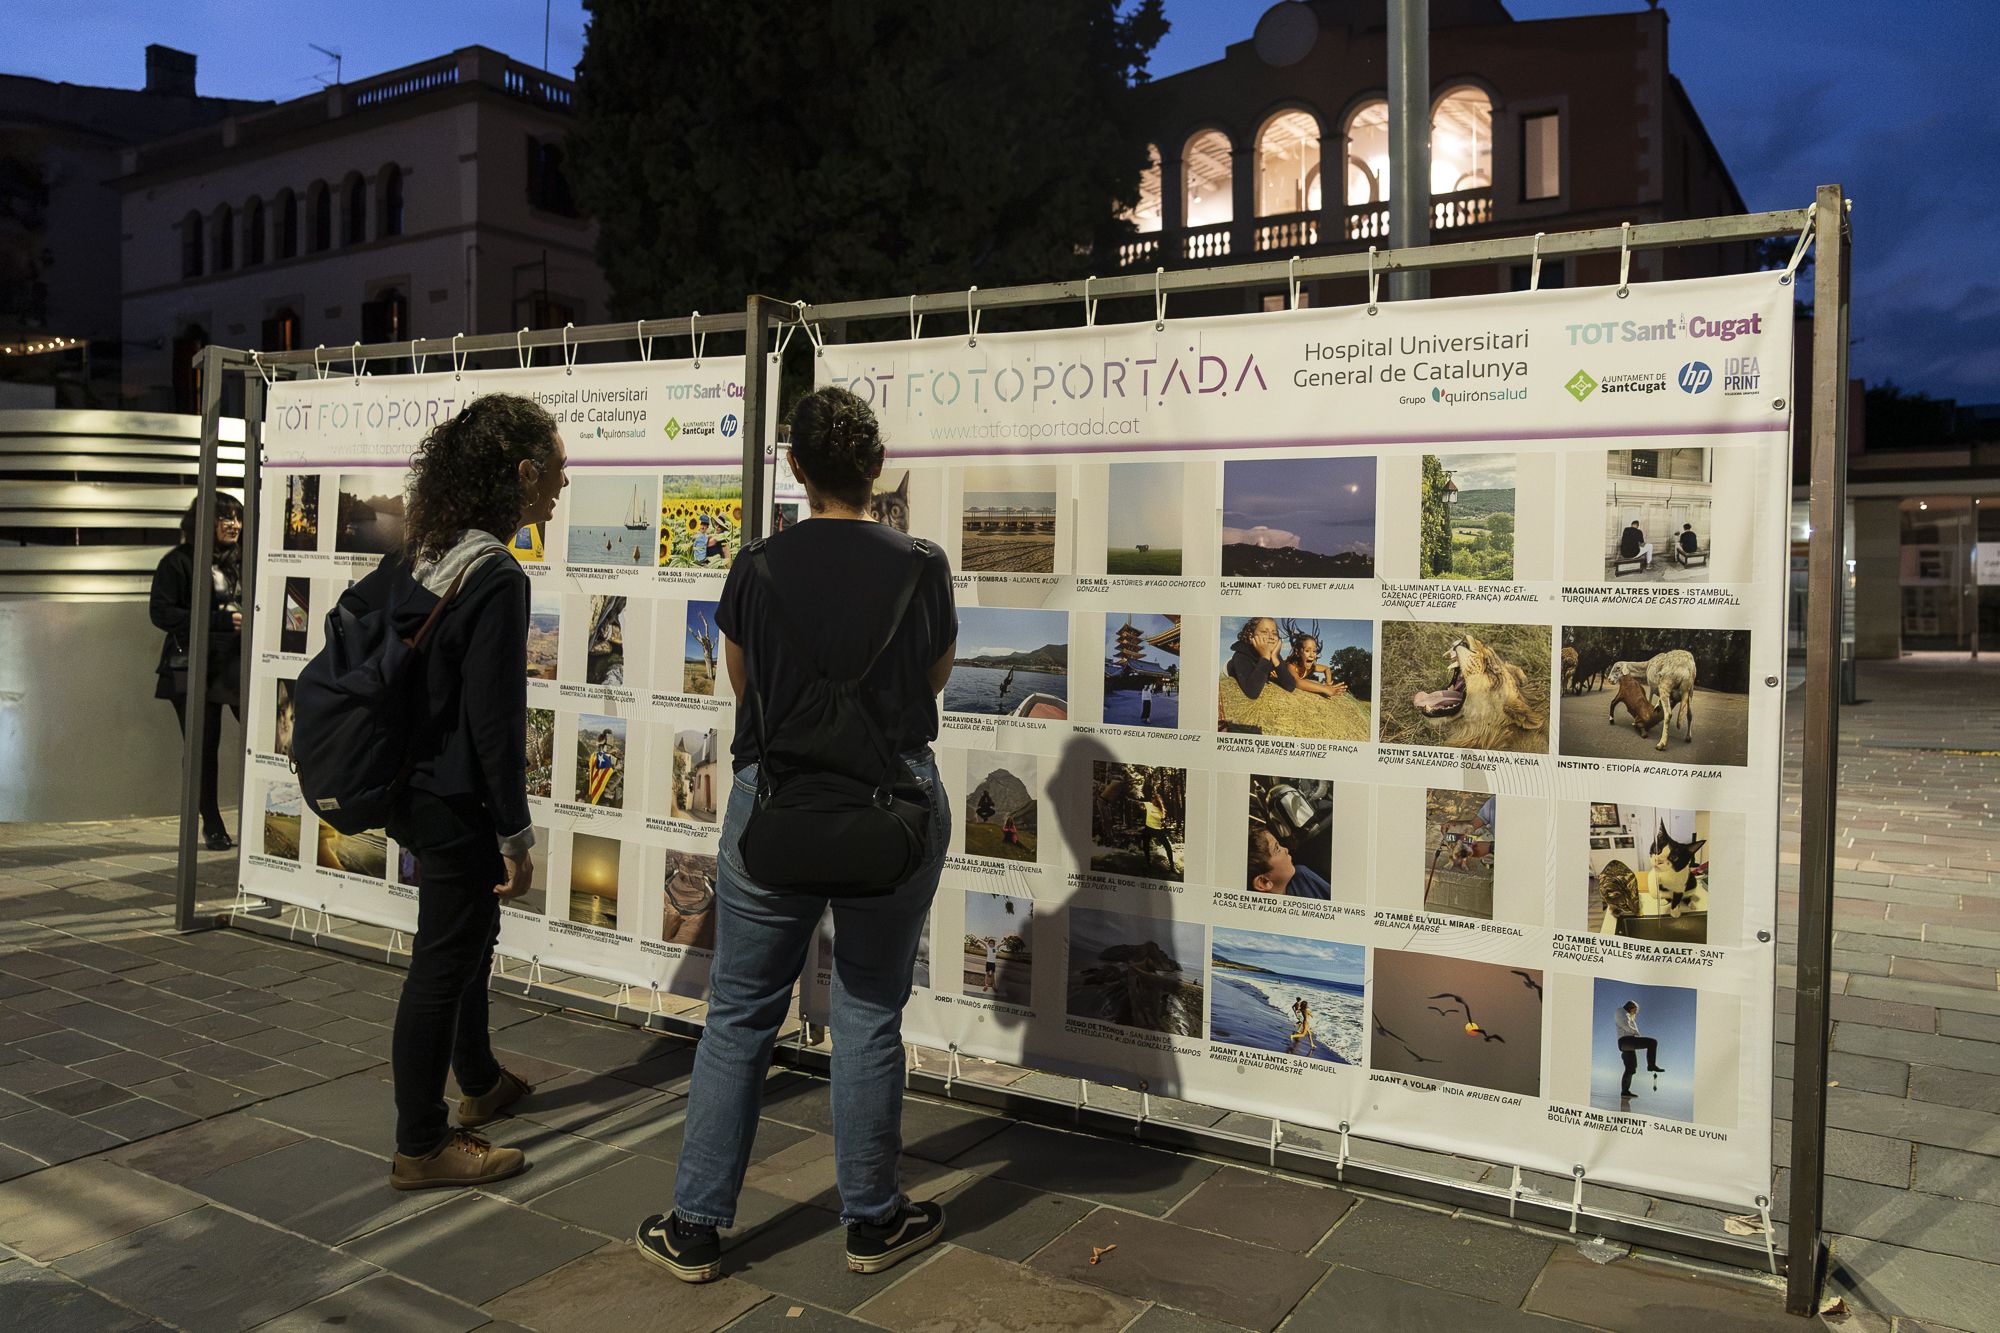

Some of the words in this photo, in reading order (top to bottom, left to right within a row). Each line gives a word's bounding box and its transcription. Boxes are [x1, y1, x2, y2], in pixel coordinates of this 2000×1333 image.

[1689, 313, 1762, 341] Cugat
[1306, 337, 1392, 362] Hospital
[1400, 329, 1529, 354] Universitari
[1294, 365, 1372, 388] General
[1380, 364, 1406, 383] de
[1413, 360, 1528, 382] Catalunya
[1725, 357, 1760, 375] IDEA
[907, 353, 1267, 407] FOTOPORTADA
[1602, 373, 1654, 383] AJUNTAMENT
[1656, 372, 1667, 381] DE
[1682, 362, 1707, 394] hp
[1725, 375, 1760, 391] PRINT
[1601, 381, 1667, 394] SantCugat
[533, 390, 578, 407] Hospital
[581, 386, 648, 403] Universitari
[1399, 395, 1426, 405] Grupo
[276, 405, 312, 431] TOT
[570, 409, 584, 423] de
[587, 408, 647, 424] Catalunya
[722, 414, 737, 437] hp
[1169, 580, 1206, 588] OCHOTECO
[1562, 587, 1613, 595] IMAGINANT
[1615, 587, 1650, 596] ALTRES
[1652, 588, 1680, 596] VIDES
[1381, 592, 1418, 600] CAZENAC
[1465, 593, 1502, 602] FRANÇA)
[1504, 594, 1539, 602] #DANIEL
[1381, 599, 1426, 609] JOANIQUET
[1427, 601, 1458, 609] ALEGRE
[1562, 595, 1600, 604] TURQUIA
[1660, 597, 1696, 605] CASTRO
[1697, 597, 1741, 606] ALMIRALL
[560, 684, 586, 692] GRANOTETA
[651, 694, 680, 702] GRONXADOR
[673, 702, 701, 710] HERNANDO
[1027, 722, 1047, 730] SELVA
[1073, 725, 1095, 734] INOCHI
[1100, 727, 1122, 736] KYOTO
[1147, 731, 1178, 740] TORNERO
[1217, 736, 1253, 746] INSTANTS
[1254, 739, 1269, 748] QUE
[1271, 740, 1295, 749] VOLEN
[1300, 742, 1316, 750] SUD
[1317, 743, 1327, 751] DE
[1328, 744, 1359, 755] FRANÇA
[1217, 744, 1255, 754] #YOLANDA
[1378, 748, 1410, 757] INSTINT
[1412, 750, 1455, 760] SALVATGE
[1514, 757, 1539, 766] KENIA
[1378, 756, 1404, 765] #QUIM
[1405, 758, 1459, 768] SANLEANDRO
[1460, 761, 1497, 772] SOLANES
[1557, 760, 1601, 771] INSTINTO
[1606, 764, 1641, 774] ETIOPÍA
[1643, 766, 1690, 778] #CARLOTA
[1690, 770, 1722, 779] PALMA
[961, 864, 981, 873] MATEO
[982, 867, 1006, 877] PUENTE
[979, 860, 1005, 870] JULIANS
[1158, 884, 1184, 894] #DAVID
[1212, 891, 1223, 899] JO
[1223, 893, 1238, 901] SOC
[1251, 896, 1278, 906] MATEO
[1282, 900, 1322, 911] EXPOSICIÓ
[1322, 904, 1342, 914] STAR
[1343, 907, 1366, 917] WARS
[1218, 899, 1238, 909] CASA
[1238, 902, 1257, 911] SEAT
[1258, 904, 1288, 915] #LAURA
[1288, 908, 1301, 916] GIL
[1301, 910, 1336, 921] MIRANDA
[549, 920, 573, 930] HORIZONTE
[615, 934, 634, 943] DAURAT
[1373, 911, 1384, 919] JO
[1386, 911, 1414, 922] TAMBÉ
[1427, 916, 1448, 926] VULL
[1449, 919, 1476, 930] MIRAR
[1481, 925, 1524, 937] BERBEGAL
[1373, 919, 1411, 930] #BLANCA
[1412, 922, 1441, 934] MARSÉ
[1552, 933, 1564, 942] JO
[1566, 934, 1597, 946] TAMBÉ
[1599, 939, 1622, 949] VULL
[1623, 942, 1652, 954] BEURE
[1662, 947, 1692, 957] GALET
[1700, 949, 1725, 960] SANT
[1552, 942, 1582, 953] CUGAT
[1583, 945, 1600, 955] DEL
[1634, 953, 1673, 963] #MARTA
[1674, 956, 1714, 967] CAMATS
[1552, 950, 1605, 964] FRANQUESA
[934, 995, 953, 1004] JORDI
[1097, 1024, 1125, 1036] TRONOS
[1172, 1046, 1202, 1057] CAMPOS
[1208, 1045, 1238, 1056] JUGANT
[1245, 1051, 1288, 1065] L'ATLÀNTIC
[1309, 1062, 1338, 1075] MIGUEL
[1209, 1053, 1238, 1065] #MIREIA
[1239, 1058, 1264, 1069] RENAU
[1264, 1062, 1304, 1076] BONASTRE
[1369, 1074, 1402, 1085] JUGANT
[1410, 1080, 1437, 1091] VOLAR
[1442, 1086, 1465, 1097] INDIA
[1466, 1091, 1501, 1103] #RUBEN
[1547, 1105, 1582, 1118] JUGANT
[1584, 1111, 1604, 1122] AMB
[1606, 1115, 1648, 1128] L'INFINIT
[1653, 1122, 1684, 1135] SALAR
[1684, 1127, 1697, 1137] DE
[1698, 1130, 1728, 1142] UYUNI
[1547, 1113, 1581, 1127] BOLÍVIA
[1583, 1120, 1619, 1133] #MIREIA
[1620, 1126, 1644, 1137] CLUA
